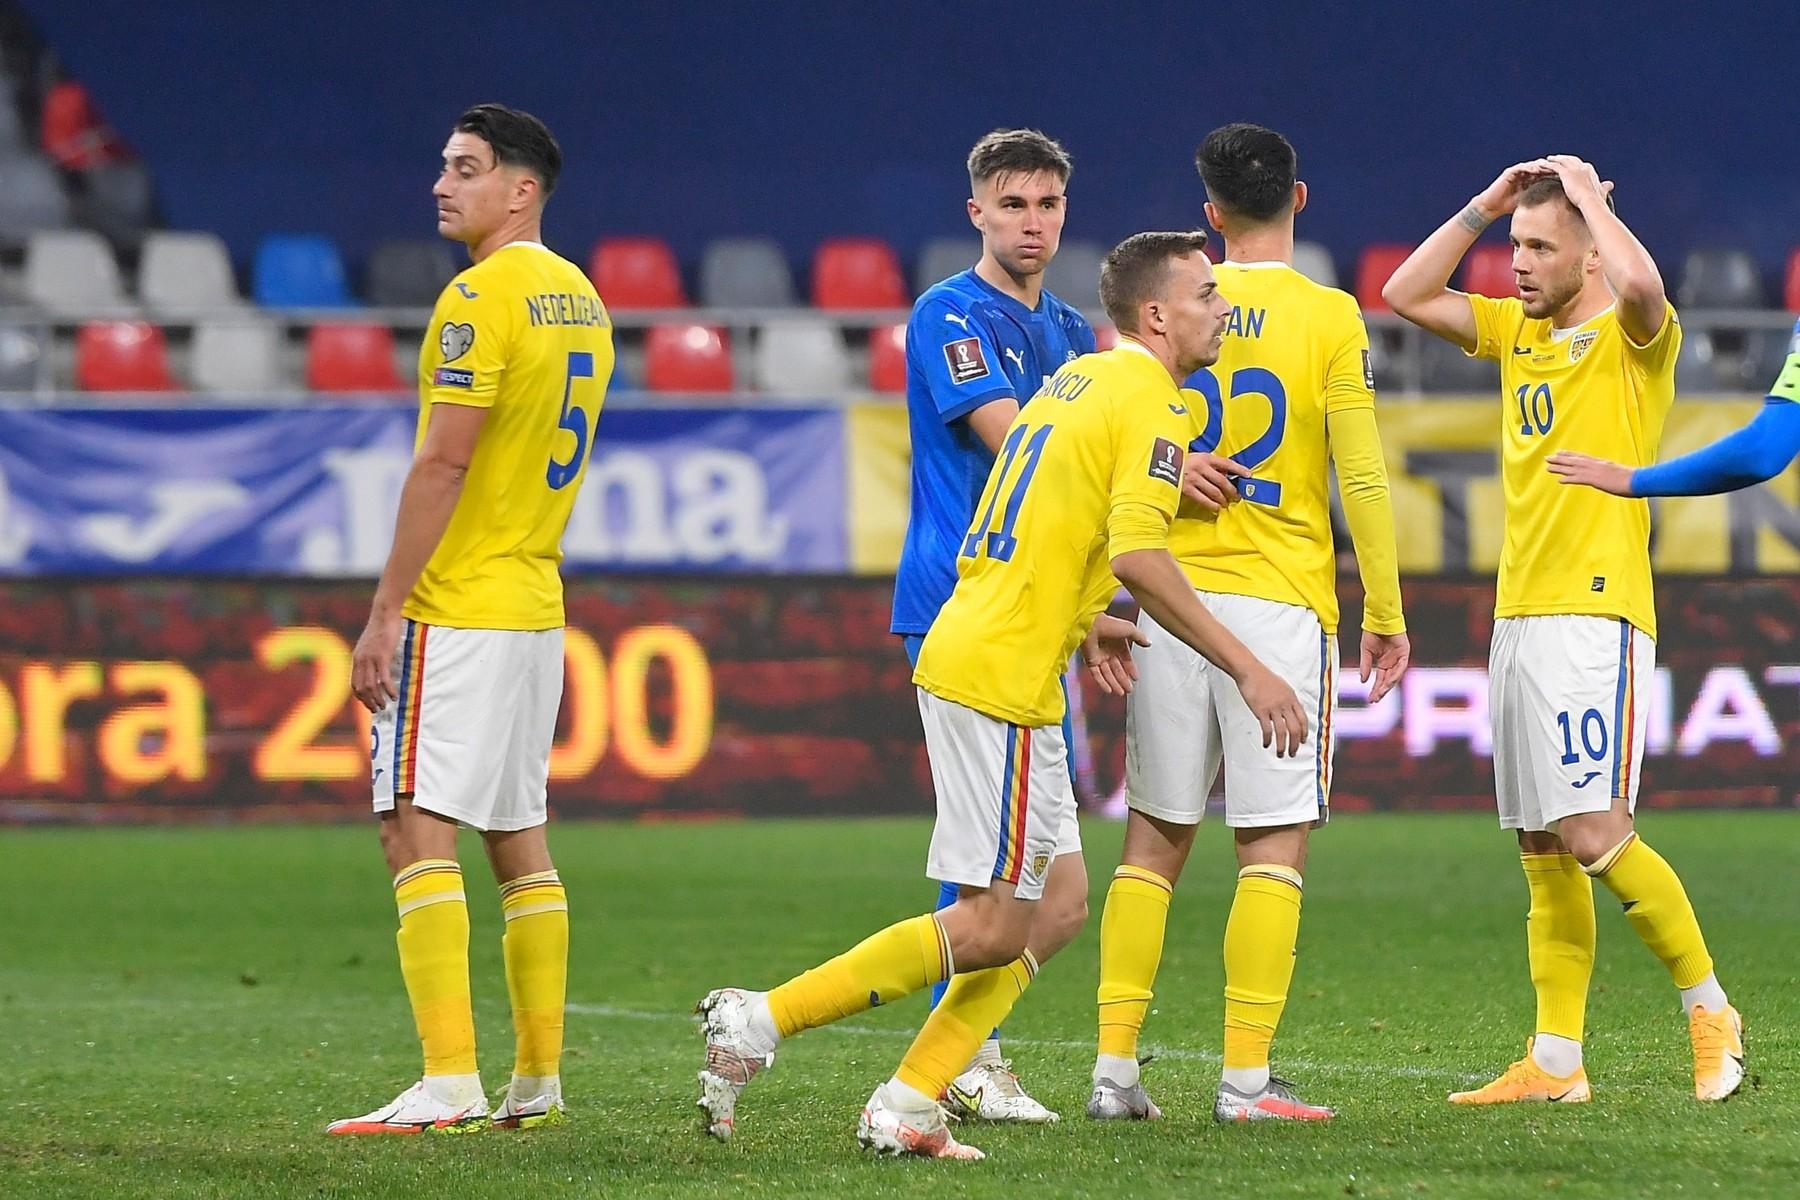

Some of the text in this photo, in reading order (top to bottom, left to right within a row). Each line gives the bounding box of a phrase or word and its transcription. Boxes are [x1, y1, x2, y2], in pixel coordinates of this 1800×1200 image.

[1226, 305, 1266, 339] AN
[547, 351, 594, 490] 5
[1516, 383, 1554, 436] 10
[962, 423, 1053, 563] 11
[0, 658, 208, 784] ra
[1556, 708, 1608, 766] 10
